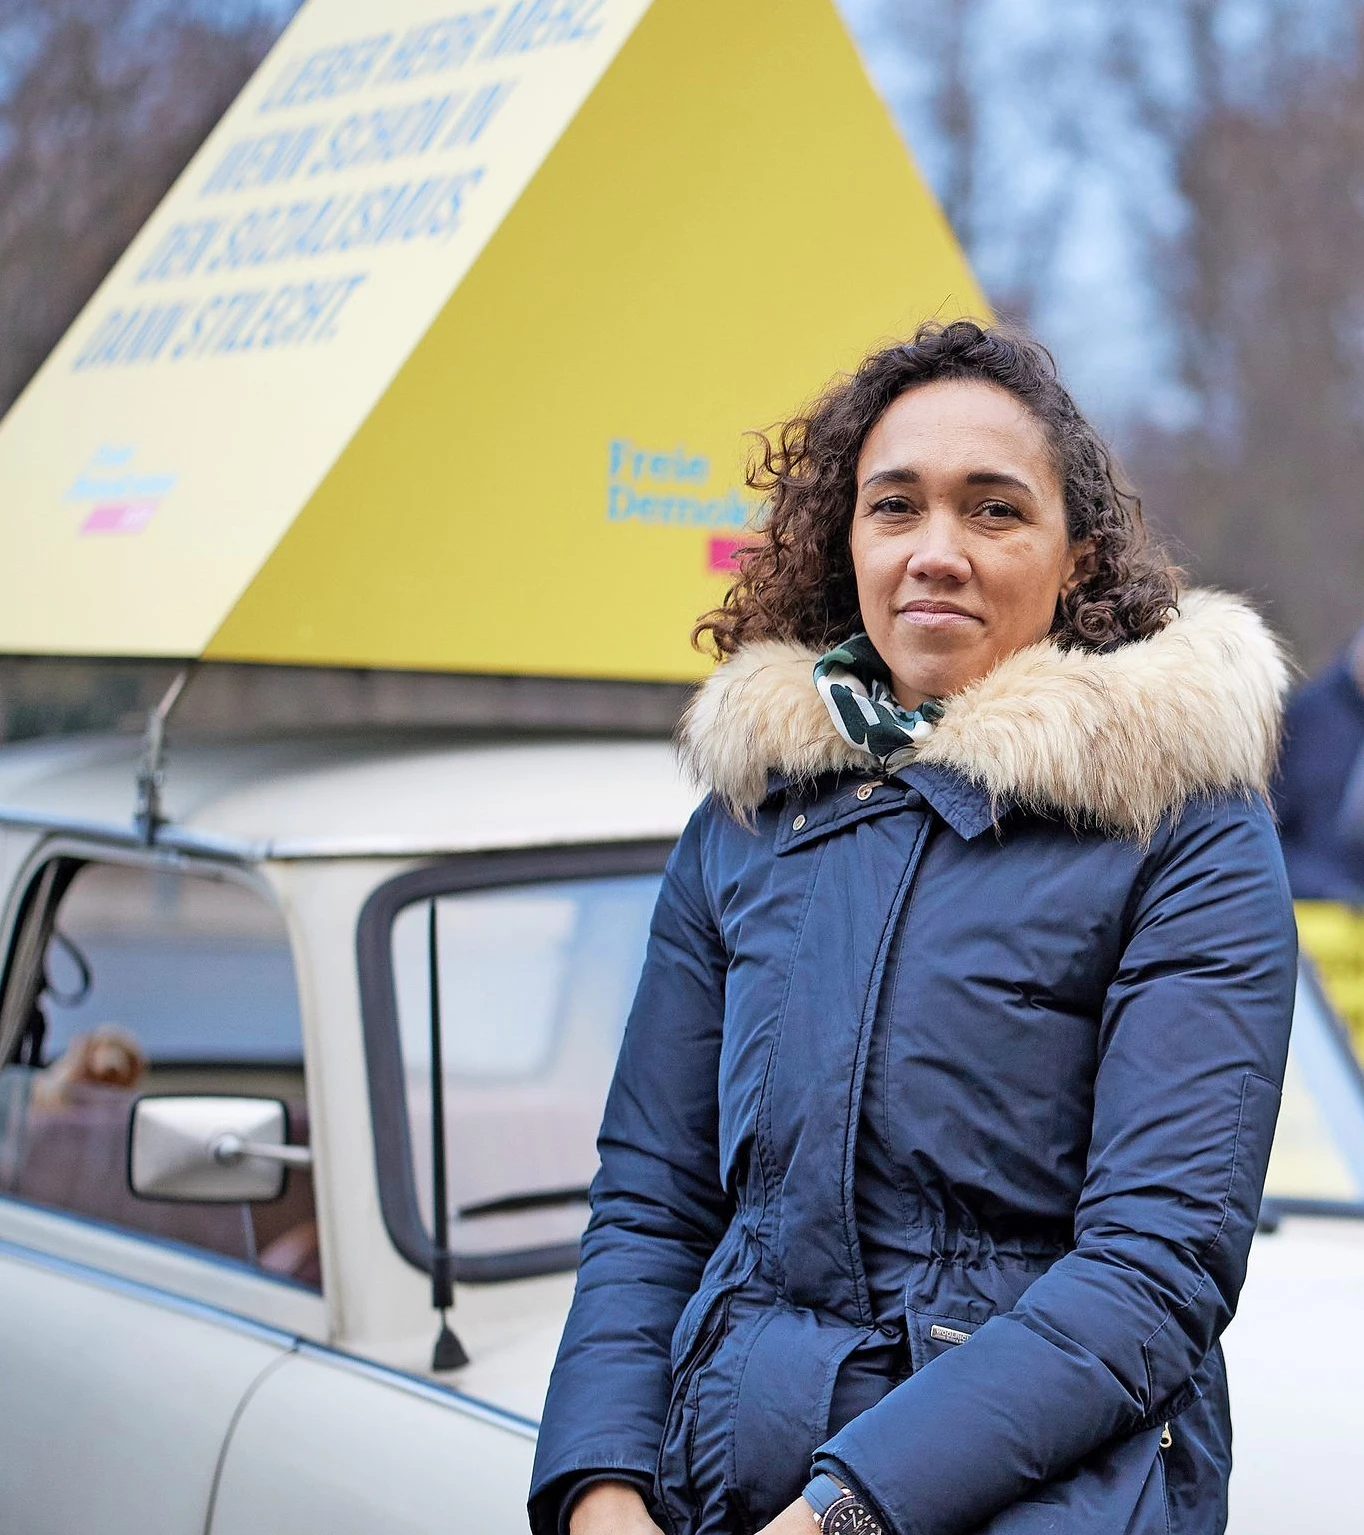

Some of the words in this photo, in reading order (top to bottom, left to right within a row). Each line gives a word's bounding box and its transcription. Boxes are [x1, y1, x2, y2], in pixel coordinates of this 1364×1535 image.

[199, 122, 322, 201] WENN
[306, 92, 468, 181] SCHON
[440, 77, 520, 153] IN
[134, 215, 224, 288] DEN
[72, 297, 190, 374] DANN
[607, 438, 709, 484] Freie
[607, 484, 770, 529] Demok
